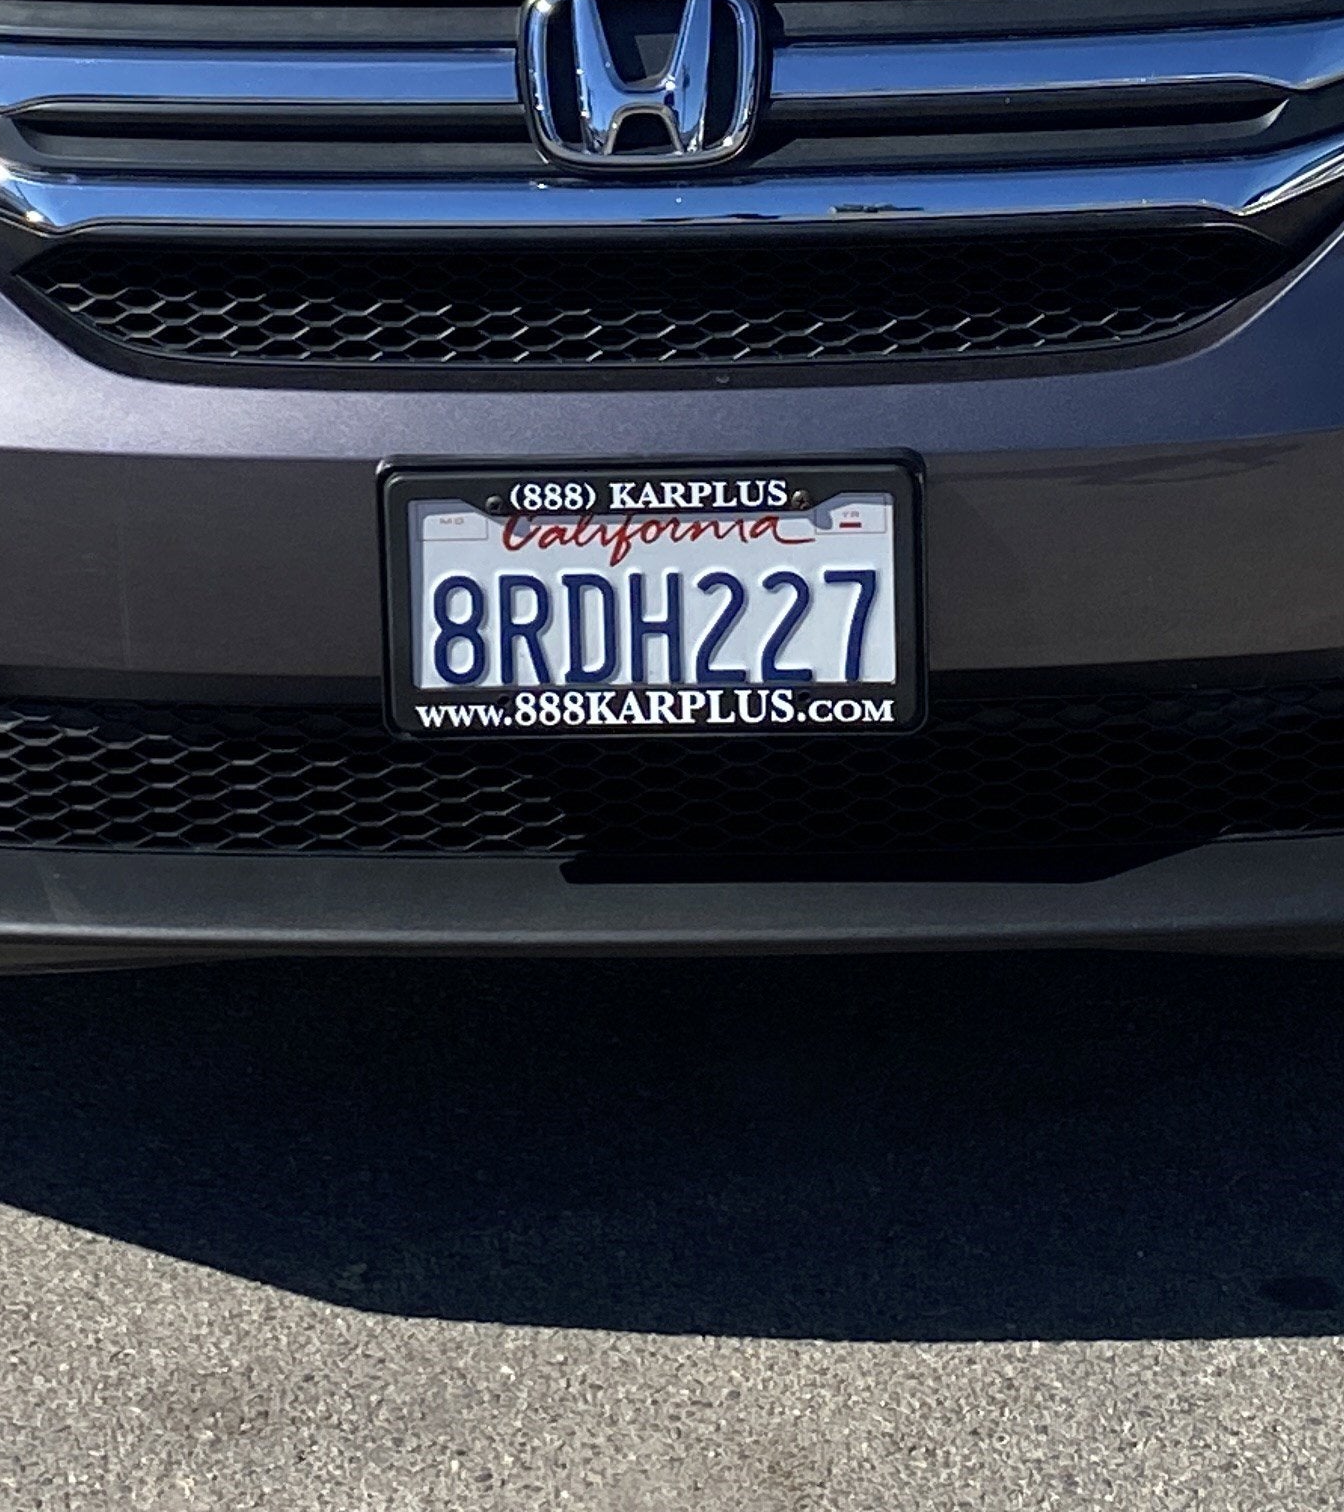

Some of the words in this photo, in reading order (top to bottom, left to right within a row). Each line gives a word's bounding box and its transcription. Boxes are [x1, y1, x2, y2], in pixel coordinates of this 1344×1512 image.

[510, 482, 596, 511] (888)
[610, 480, 788, 509] KARPLUS
[502, 511, 816, 567] California
[432, 568, 878, 685] 8RDH227
